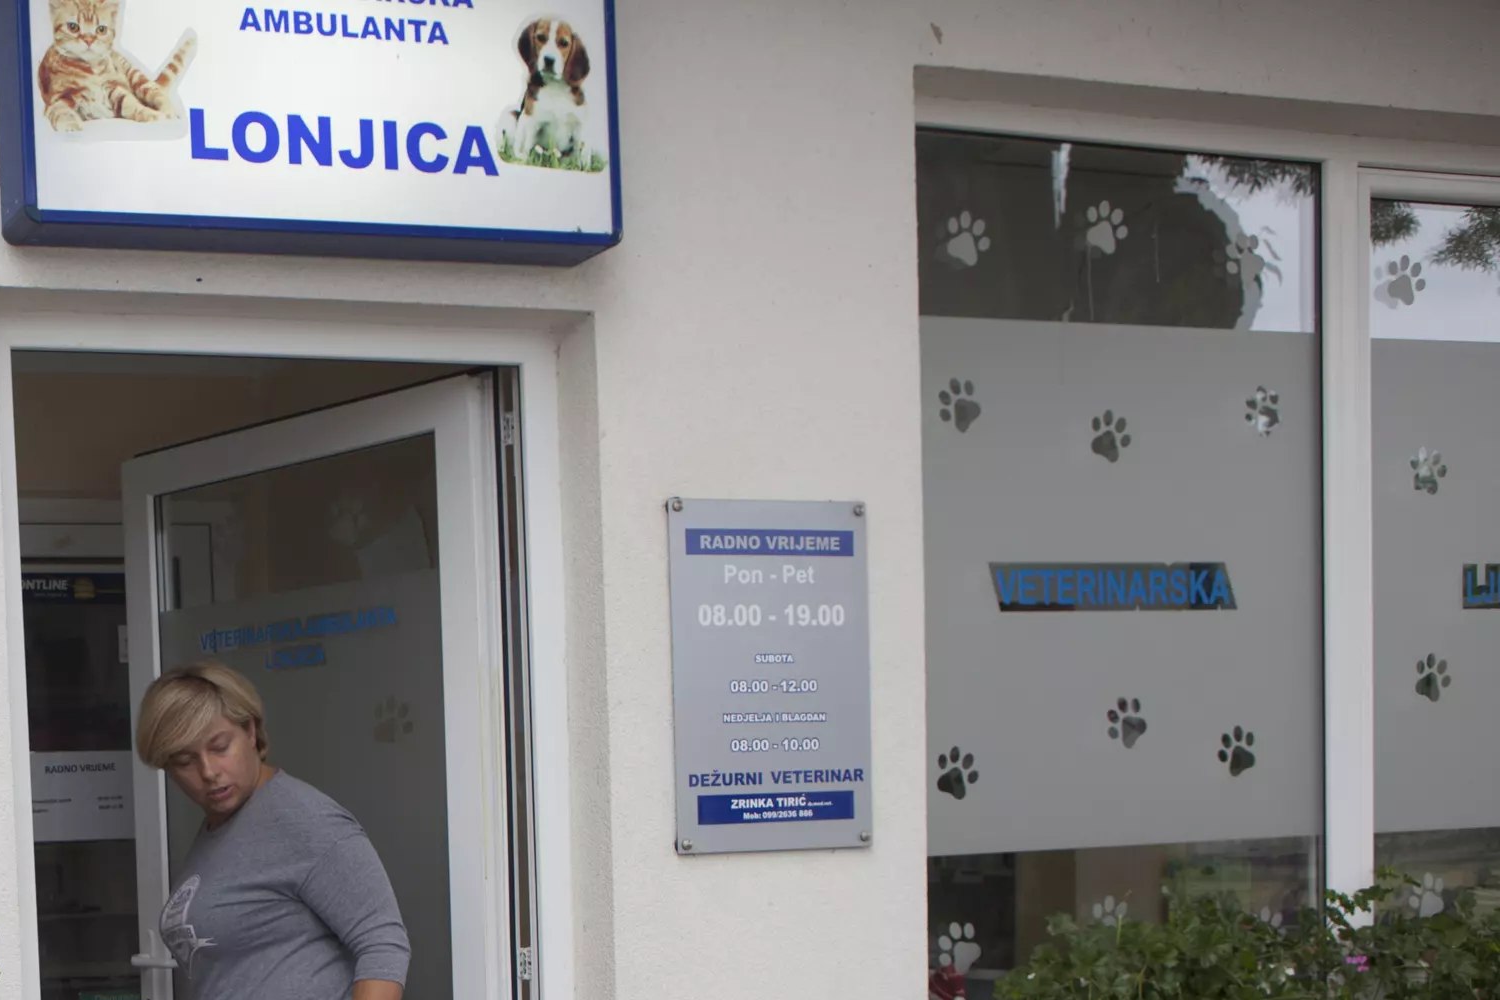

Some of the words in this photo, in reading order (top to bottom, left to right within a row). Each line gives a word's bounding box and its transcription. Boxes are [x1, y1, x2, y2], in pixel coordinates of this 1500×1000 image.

[240, 7, 449, 44] AMBULANTA
[188, 108, 499, 176] LONJICA
[700, 535, 761, 549] RADNO
[765, 536, 841, 550] VRIJEME
[724, 564, 763, 584] Pon
[782, 564, 815, 584] Pet
[996, 569, 1231, 606] VETERINARSKA
[1466, 570, 1500, 603] LJ
[698, 604, 762, 626] 08.00
[784, 604, 845, 626] 19.00
[755, 654, 794, 663] SUBOTA
[730, 680, 769, 693] 08.00
[780, 680, 818, 692] 12.00
[723, 713, 773, 723] NEDJELJA
[781, 712, 827, 722] BLAGDAN
[731, 739, 769, 752] 08.00
[782, 738, 820, 751] 10.00
[44, 764, 77, 774] RADNO
[688, 769, 762, 787] DEŽURNI
[771, 768, 864, 785] VETERINAR
[730, 799, 774, 809] ZRINKA
[776, 794, 806, 807] TIRIĆ
[743, 812, 762, 820] Mob:
